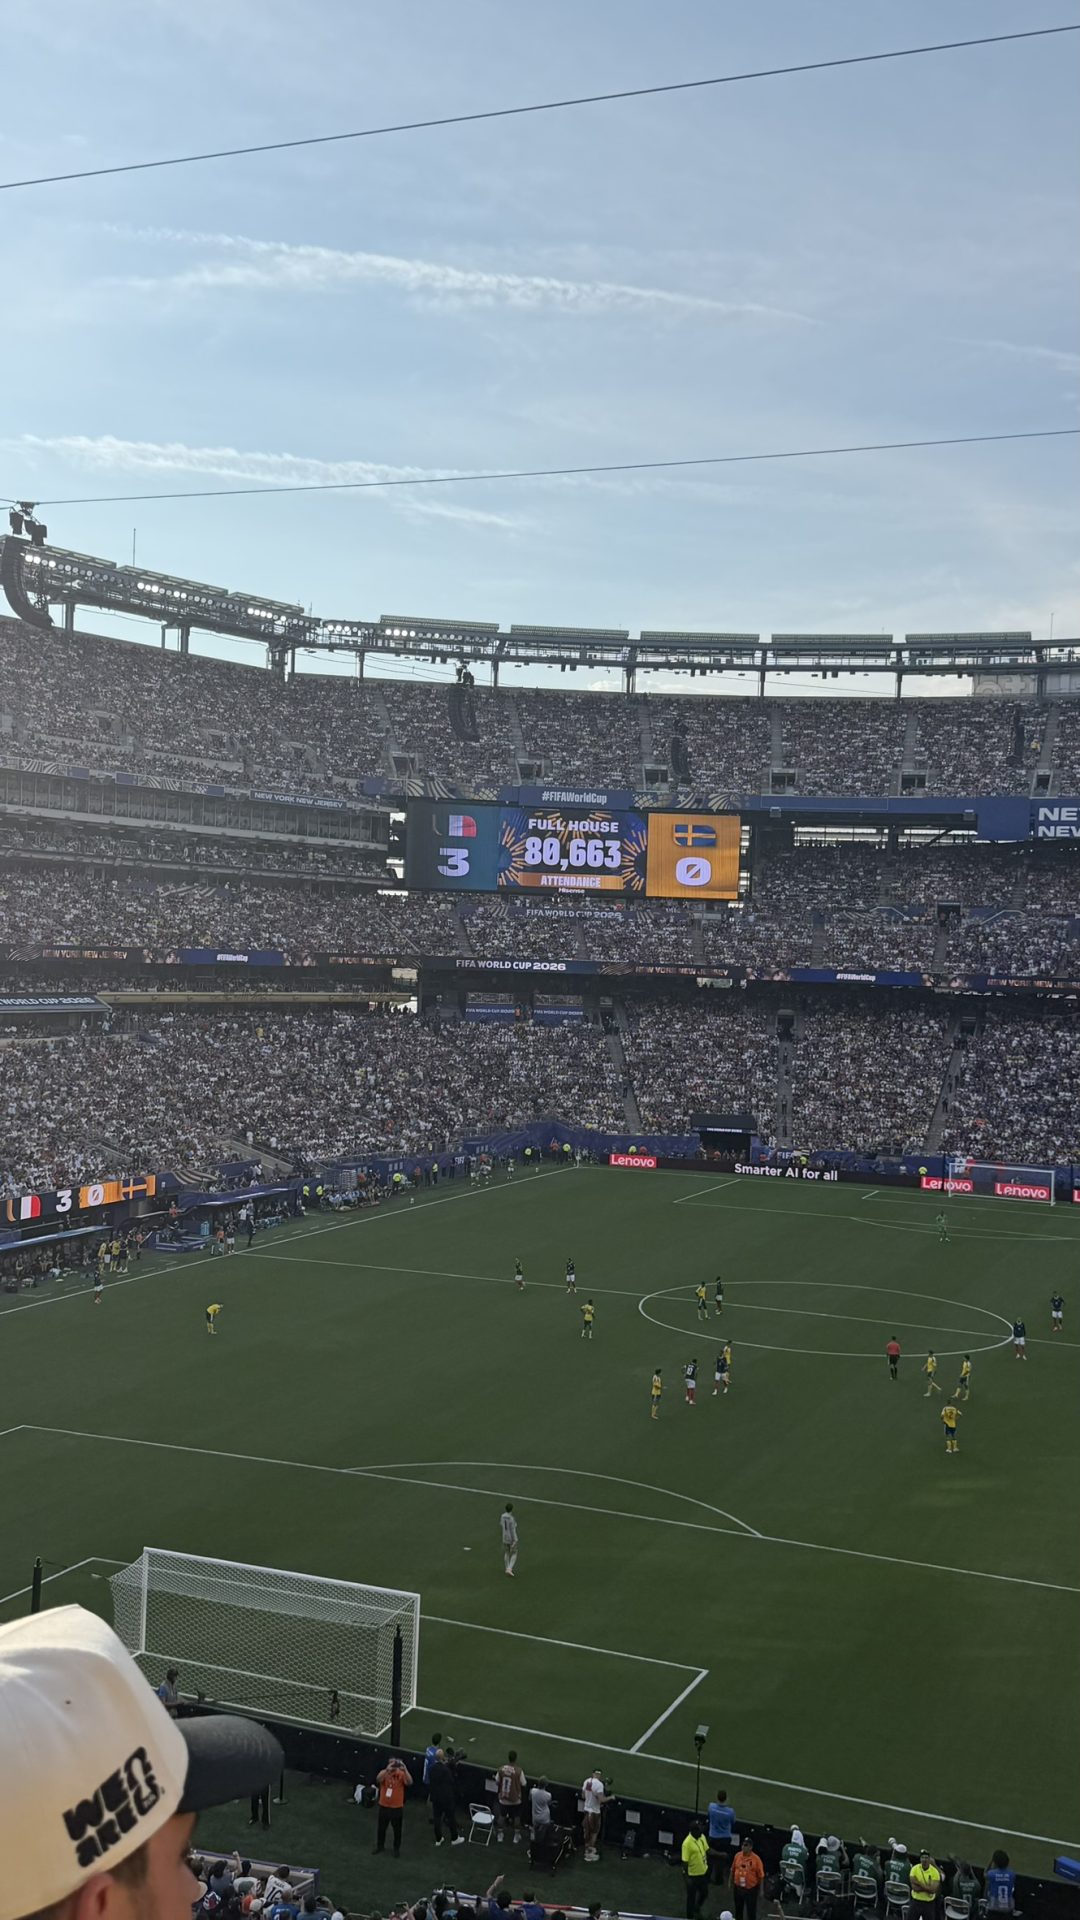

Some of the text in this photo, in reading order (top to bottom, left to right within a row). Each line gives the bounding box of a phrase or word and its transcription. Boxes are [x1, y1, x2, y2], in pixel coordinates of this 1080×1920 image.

[254, 791, 343, 809] NEW YORK NEW JERSEY
[542, 791, 608, 804] #FIFAWorldCup
[1038, 807, 1080, 821] NE
[528, 818, 619, 833] FULL HOUSE
[524, 837, 622, 871] 80,663
[437, 847, 470, 877] 3
[675, 857, 712, 886] 0
[540, 875, 601, 888] ATTENDANCE
[558, 887, 585, 895] Hisense
[526, 909, 544, 917] FIFA
[545, 909, 575, 918] WORLD
[456, 959, 567, 971] FIFA WORLD CUP 2026
[611, 1154, 655, 1168] Lenovo
[734, 1163, 838, 1181] Smarter AI for all
[921, 1177, 972, 1192] Lenovo
[996, 1183, 1047, 1199] Lenovo
[56, 1184, 105, 1213] 3 0
